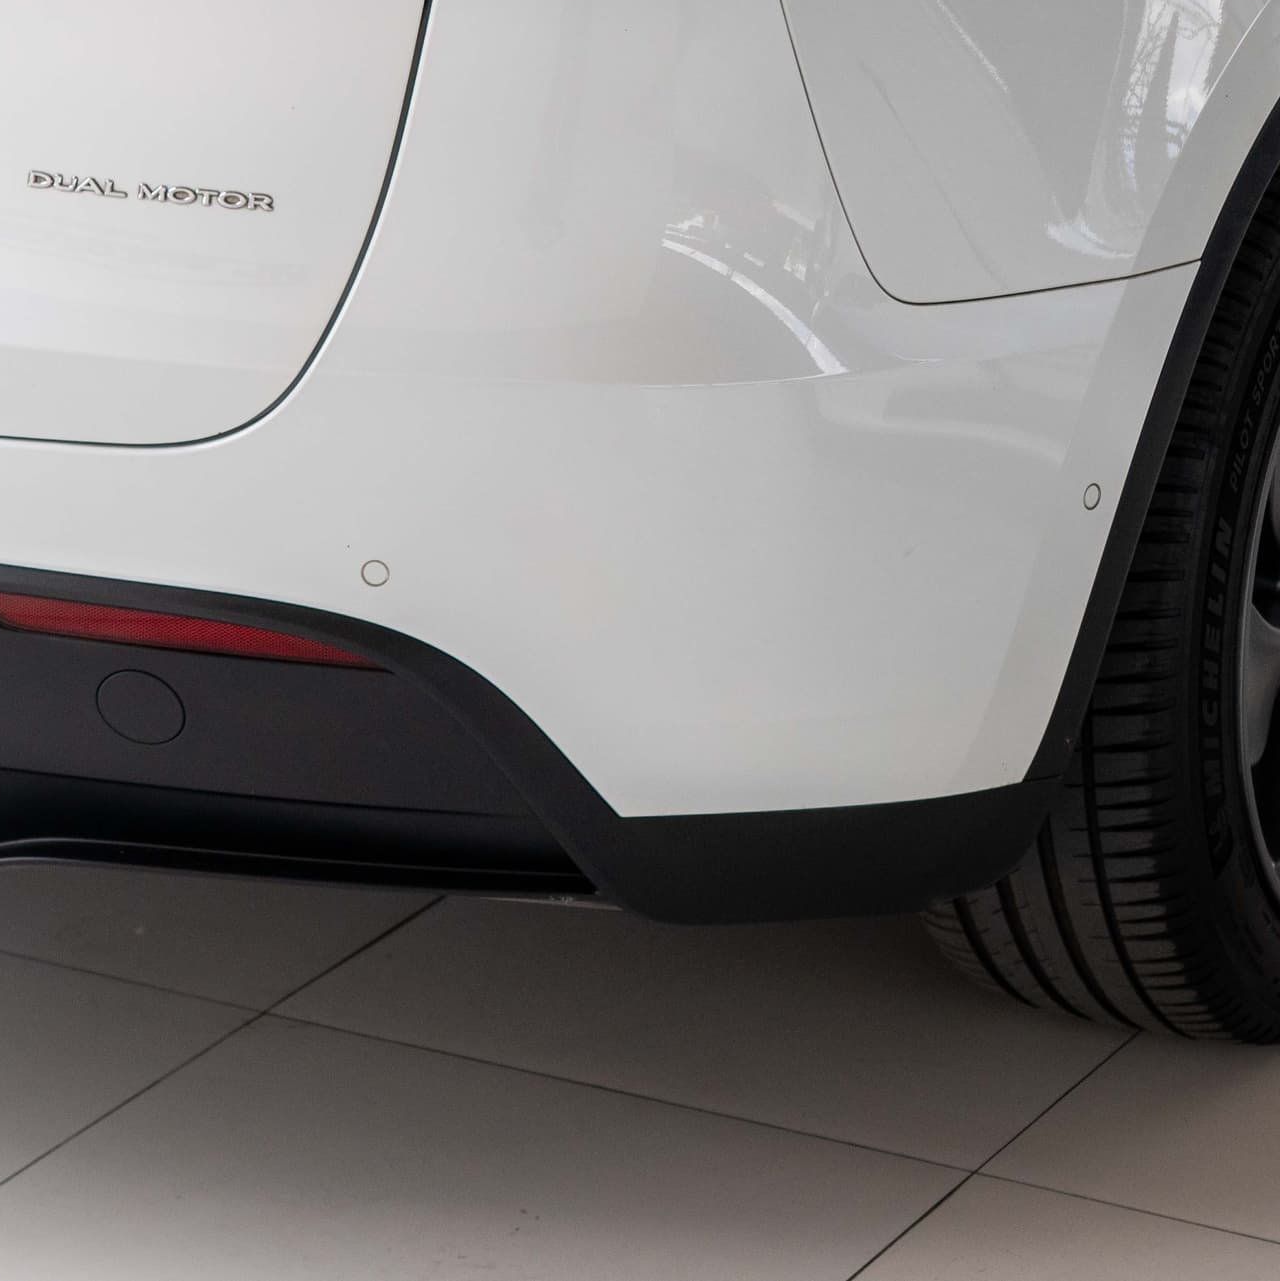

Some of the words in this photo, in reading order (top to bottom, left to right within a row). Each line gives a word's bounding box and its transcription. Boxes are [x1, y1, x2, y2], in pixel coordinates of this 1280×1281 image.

[27, 170, 128, 199] DUAL
[137, 182, 275, 212] MOTOR
[1201, 517, 1233, 797] MICHELIN
[1229, 408, 1254, 494] PILOT
